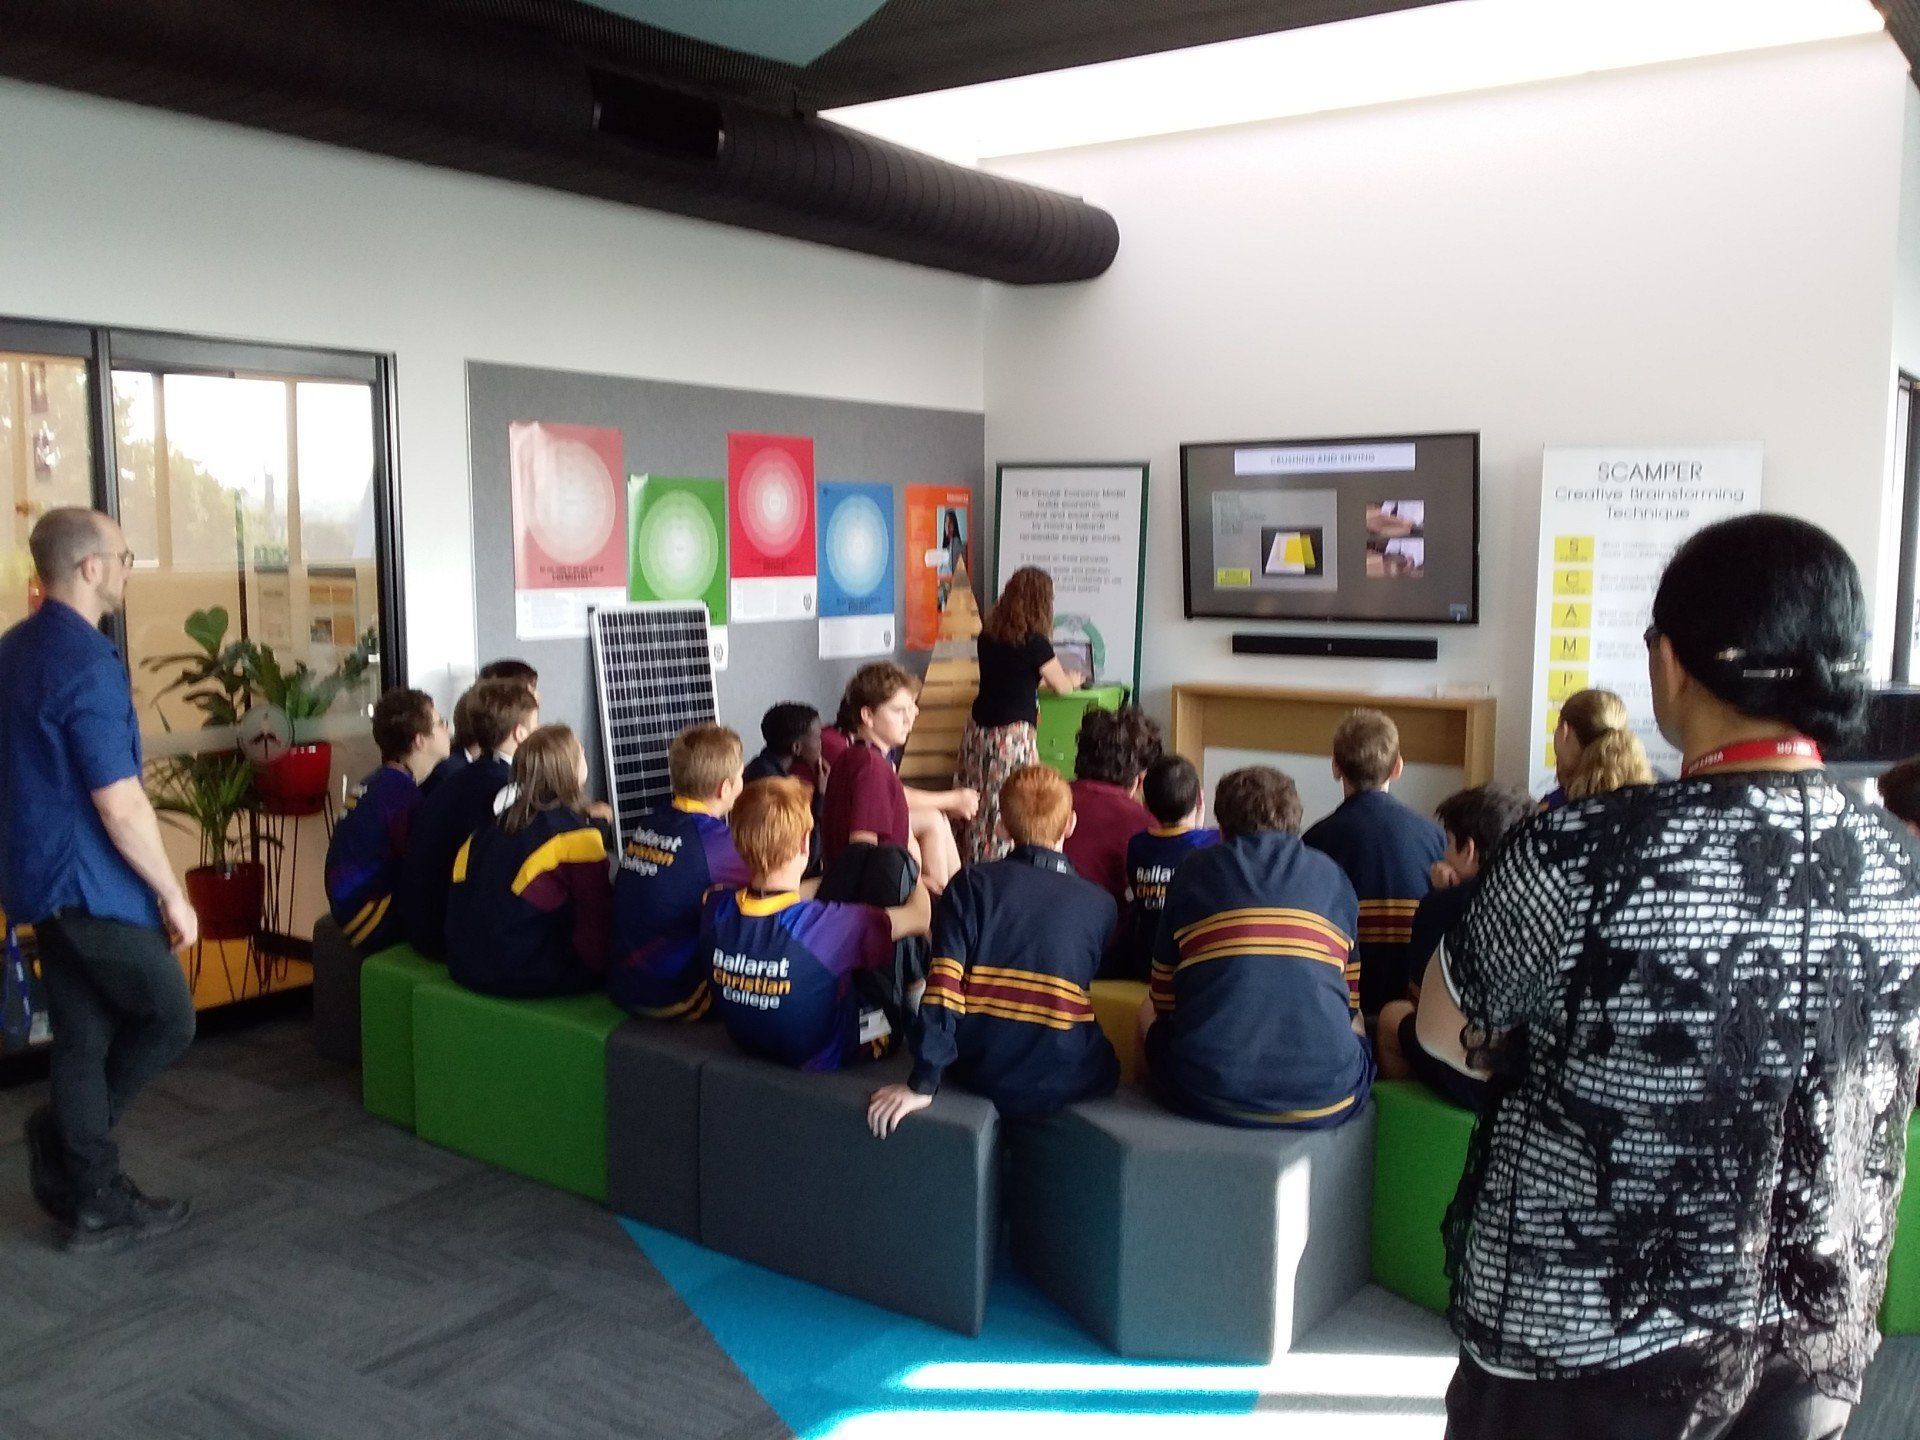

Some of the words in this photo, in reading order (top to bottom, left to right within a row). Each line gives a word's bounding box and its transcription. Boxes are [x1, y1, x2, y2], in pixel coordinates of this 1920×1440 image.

[1317, 453, 1337, 464] AND
[1598, 461, 1703, 483] SCAMPER
[1555, 486, 1624, 502] Creative
[1630, 486, 1745, 503] Brainstorming
[1607, 505, 1691, 522] Technique
[1569, 536, 1579, 555] S
[1565, 570, 1580, 588] C
[1565, 603, 1577, 620] A
[1563, 636, 1577, 653] M
[1563, 671, 1573, 687] P
[1136, 865, 1175, 883] Balla
[1144, 896, 1165, 910] Coll
[713, 947, 790, 978] Ballarat
[713, 968, 791, 996] Christian
[722, 985, 780, 1011] College
